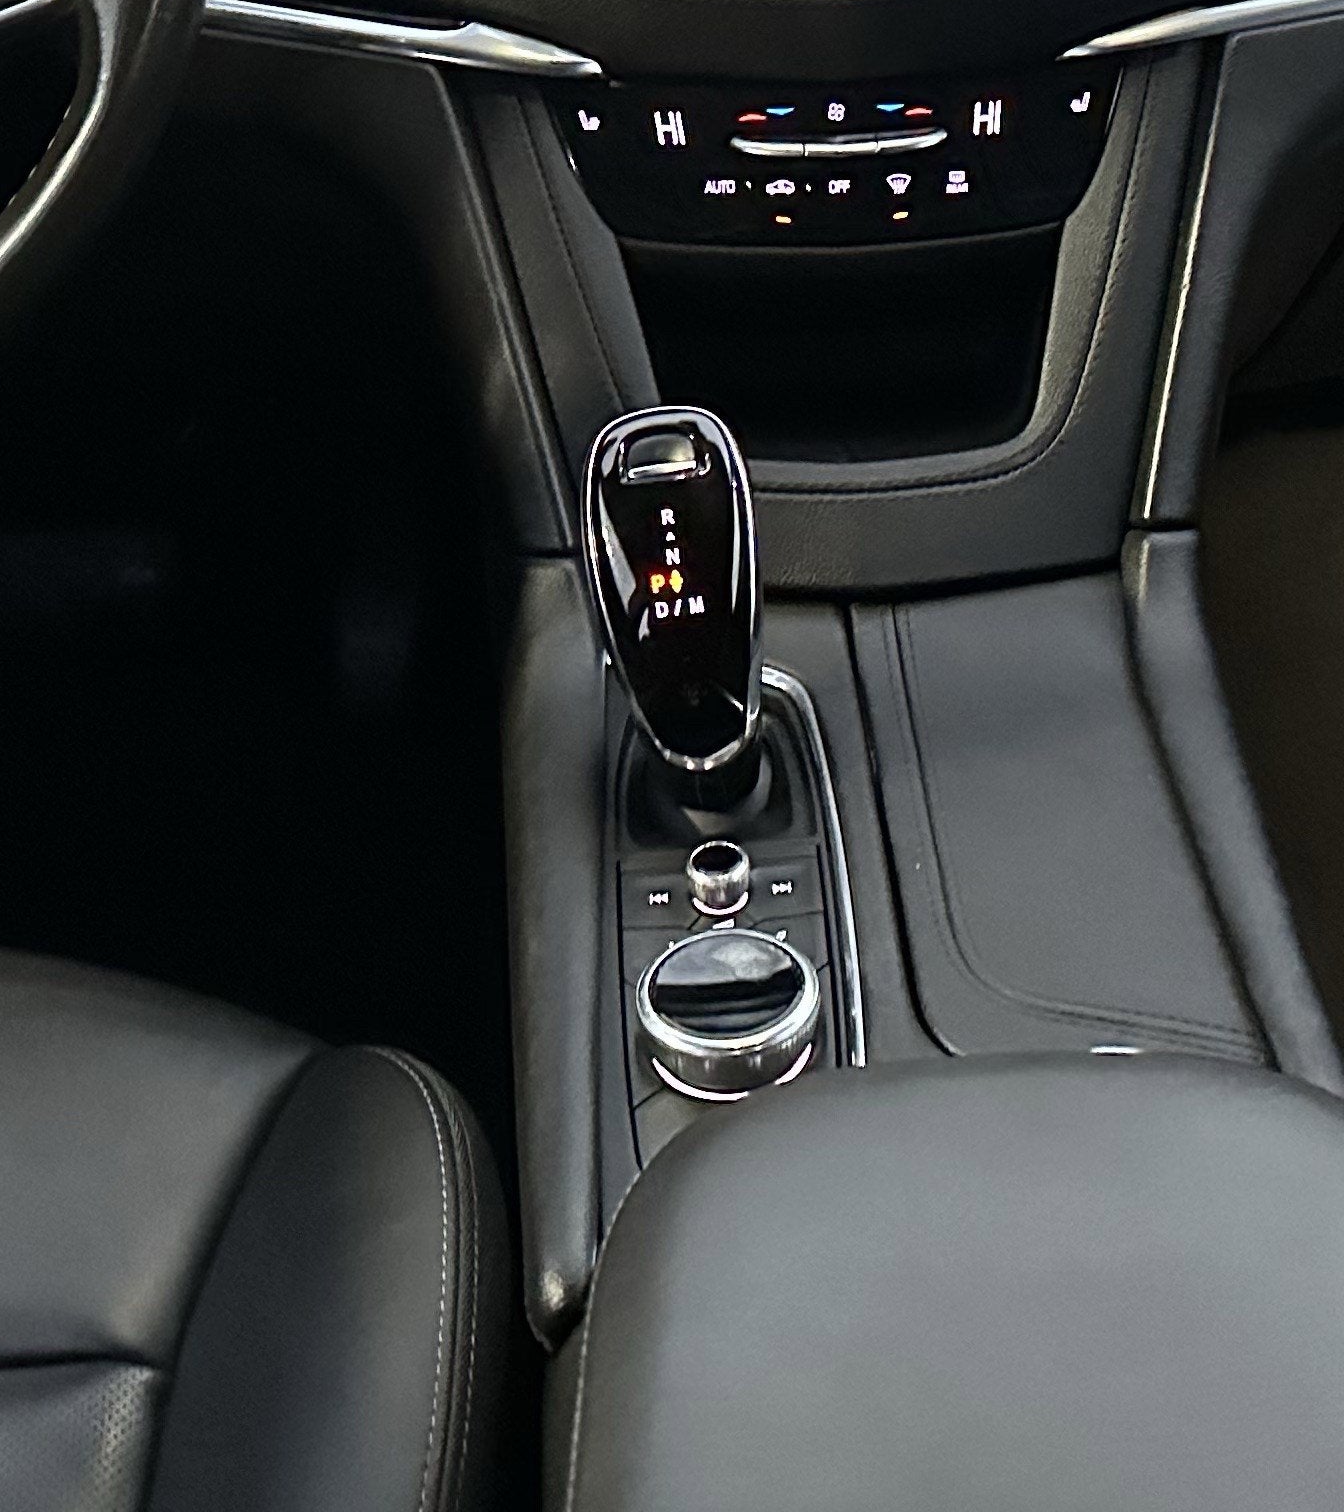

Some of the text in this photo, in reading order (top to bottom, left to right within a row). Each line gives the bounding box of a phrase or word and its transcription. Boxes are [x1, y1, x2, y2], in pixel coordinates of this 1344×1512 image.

[972, 100, 1002, 136] HI
[654, 110, 686, 146] HI
[704, 179, 736, 194] AUTO
[828, 179, 851, 194] OFF
[660, 508, 675, 525] R
[665, 547, 681, 565] N
[650, 574, 665, 593] P
